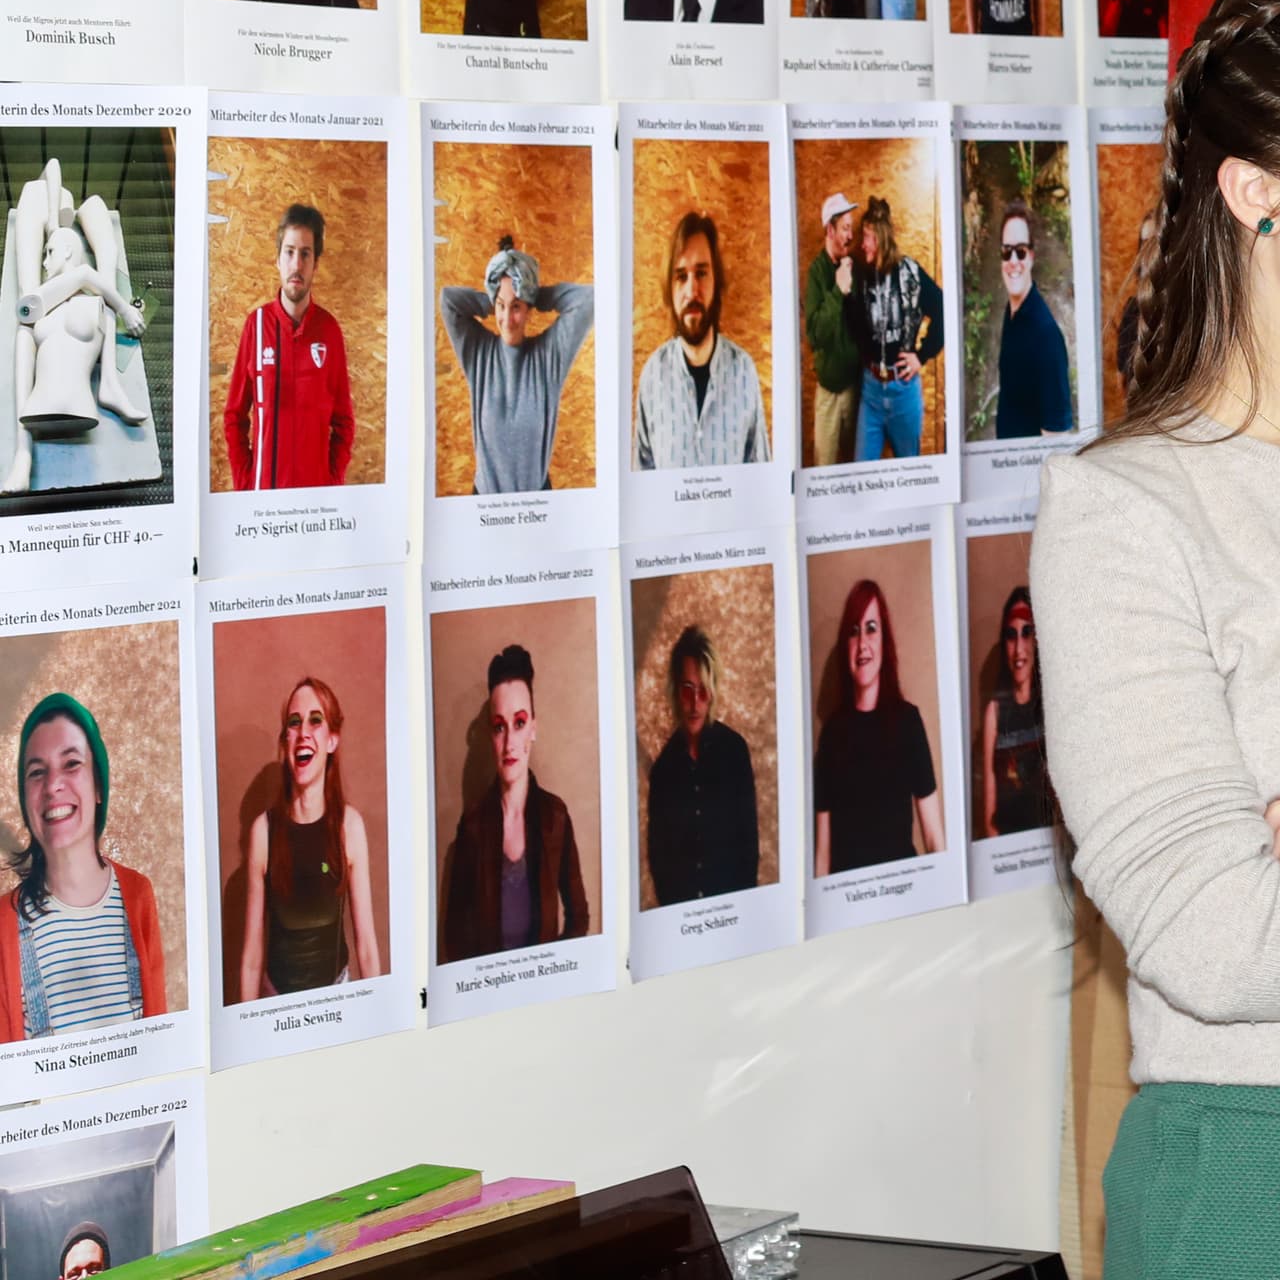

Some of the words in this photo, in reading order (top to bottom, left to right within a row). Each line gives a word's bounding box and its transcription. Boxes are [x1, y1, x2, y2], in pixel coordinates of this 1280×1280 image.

[25, 29, 77, 45] Dominik
[78, 31, 116, 46] Busch
[254, 42, 287, 58] Nicole
[288, 44, 333, 62] Brugger
[464, 54, 502, 70] Chantal
[502, 56, 549, 71] Buntschu
[669, 53, 693, 67] Alain
[693, 54, 723, 67] Berset
[29, 102, 50, 116] des
[52, 103, 94, 116] Monats
[95, 103, 155, 117] Dezember
[157, 106, 192, 117] 2020
[209, 108, 269, 123] Mitarbeiter
[269, 110, 288, 123] des
[289, 111, 326, 125] Monats
[326, 113, 362, 126] Januar
[362, 116, 384, 127] 2021
[429, 118, 488, 132] Mitarbeiterin
[488, 119, 506, 132] des
[507, 120, 538, 134] Monats
[537, 121, 571, 135] Februar
[571, 125, 596, 135] 2021
[636, 118, 683, 130] Mitarbeiter
[683, 119, 698, 131] des
[698, 119, 728, 132] Monats
[727, 120, 747, 133] März
[674, 489, 702, 502] Lukas
[701, 487, 733, 500] Gernet
[234, 523, 258, 539] Jery
[261, 520, 299, 538] Sigrist
[300, 518, 327, 534] (und
[329, 516, 357, 532] Elka)
[479, 515, 517, 527] Simone
[517, 510, 549, 525] Felber
[8, 534, 80, 554] Mannequin
[82, 532, 102, 548] für
[103, 530, 130, 546] CHF
[634, 555, 679, 569] Mitarbeiter
[678, 552, 693, 565] des
[693, 550, 724, 562] Monats
[724, 547, 746, 559] März
[429, 575, 486, 593] Mitarbeiterin
[486, 574, 504, 587] des
[504, 573, 538, 585] Monats
[538, 569, 572, 583] Februar
[572, 568, 594, 579] 2022
[208, 595, 275, 613] Mitarbeiterin
[276, 593, 294, 607] des
[295, 591, 332, 604] Monats
[332, 589, 366, 601] Januar
[366, 587, 388, 598] 2022
[39, 609, 60, 623] des
[62, 606, 104, 620] Monats
[105, 600, 156, 617] Dezember
[156, 600, 181, 611] 2021
[679, 923, 704, 936] Greg
[703, 915, 740, 930] Schärer
[455, 976, 483, 994] Marie
[483, 970, 517, 989] Sophie
[517, 969, 536, 981] von
[537, 959, 579, 977] Reibnitz
[273, 1015, 302, 1033] Julia
[303, 1009, 343, 1027] Sewing
[34, 1058, 67, 1075] Nina
[68, 1043, 138, 1069] Steinemann
[0, 1127, 40, 1145] rbeiter
[40, 1122, 60, 1137] des
[62, 1115, 103, 1133] Monats
[105, 1103, 160, 1124] Dezember
[160, 1099, 188, 1113] 2022
